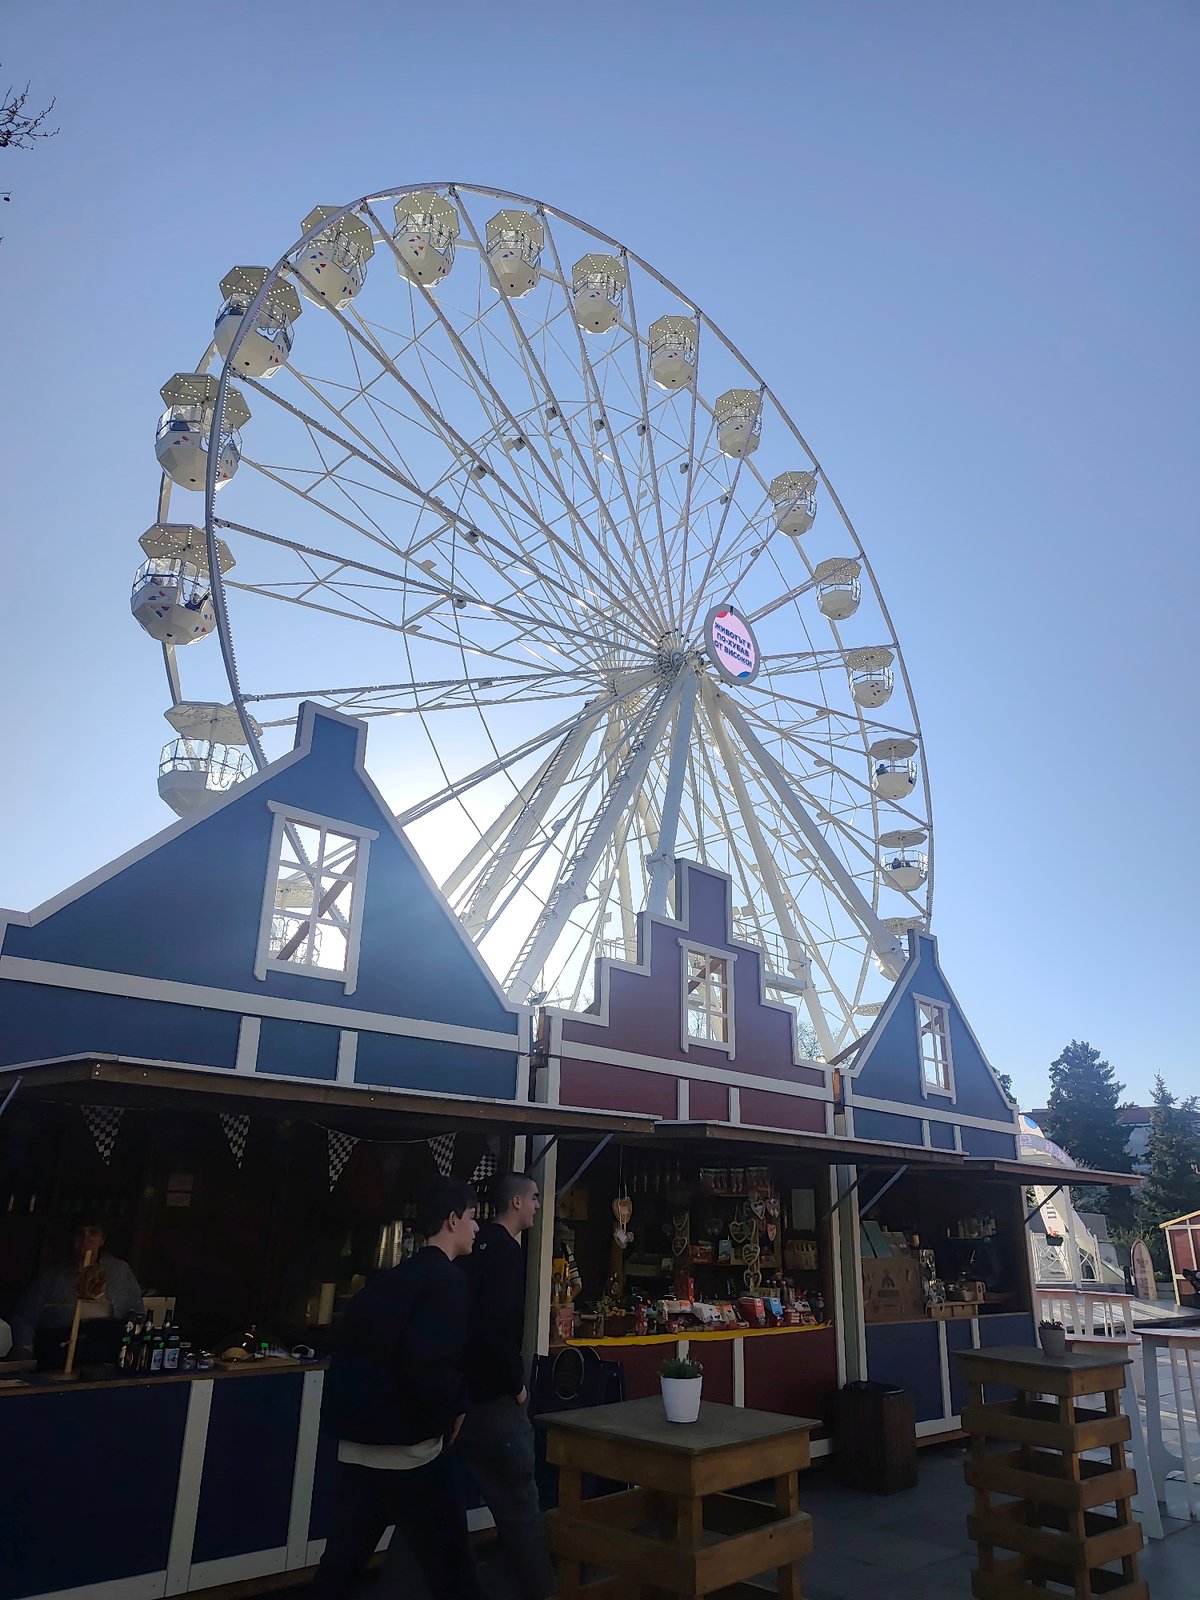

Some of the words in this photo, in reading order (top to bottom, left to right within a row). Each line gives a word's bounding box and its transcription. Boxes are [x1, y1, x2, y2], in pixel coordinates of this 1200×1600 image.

[714, 640, 723, 651] ОТ
[716, 632, 750, 657] ПО-ХУБАВ
[746, 642, 752, 650] Е
